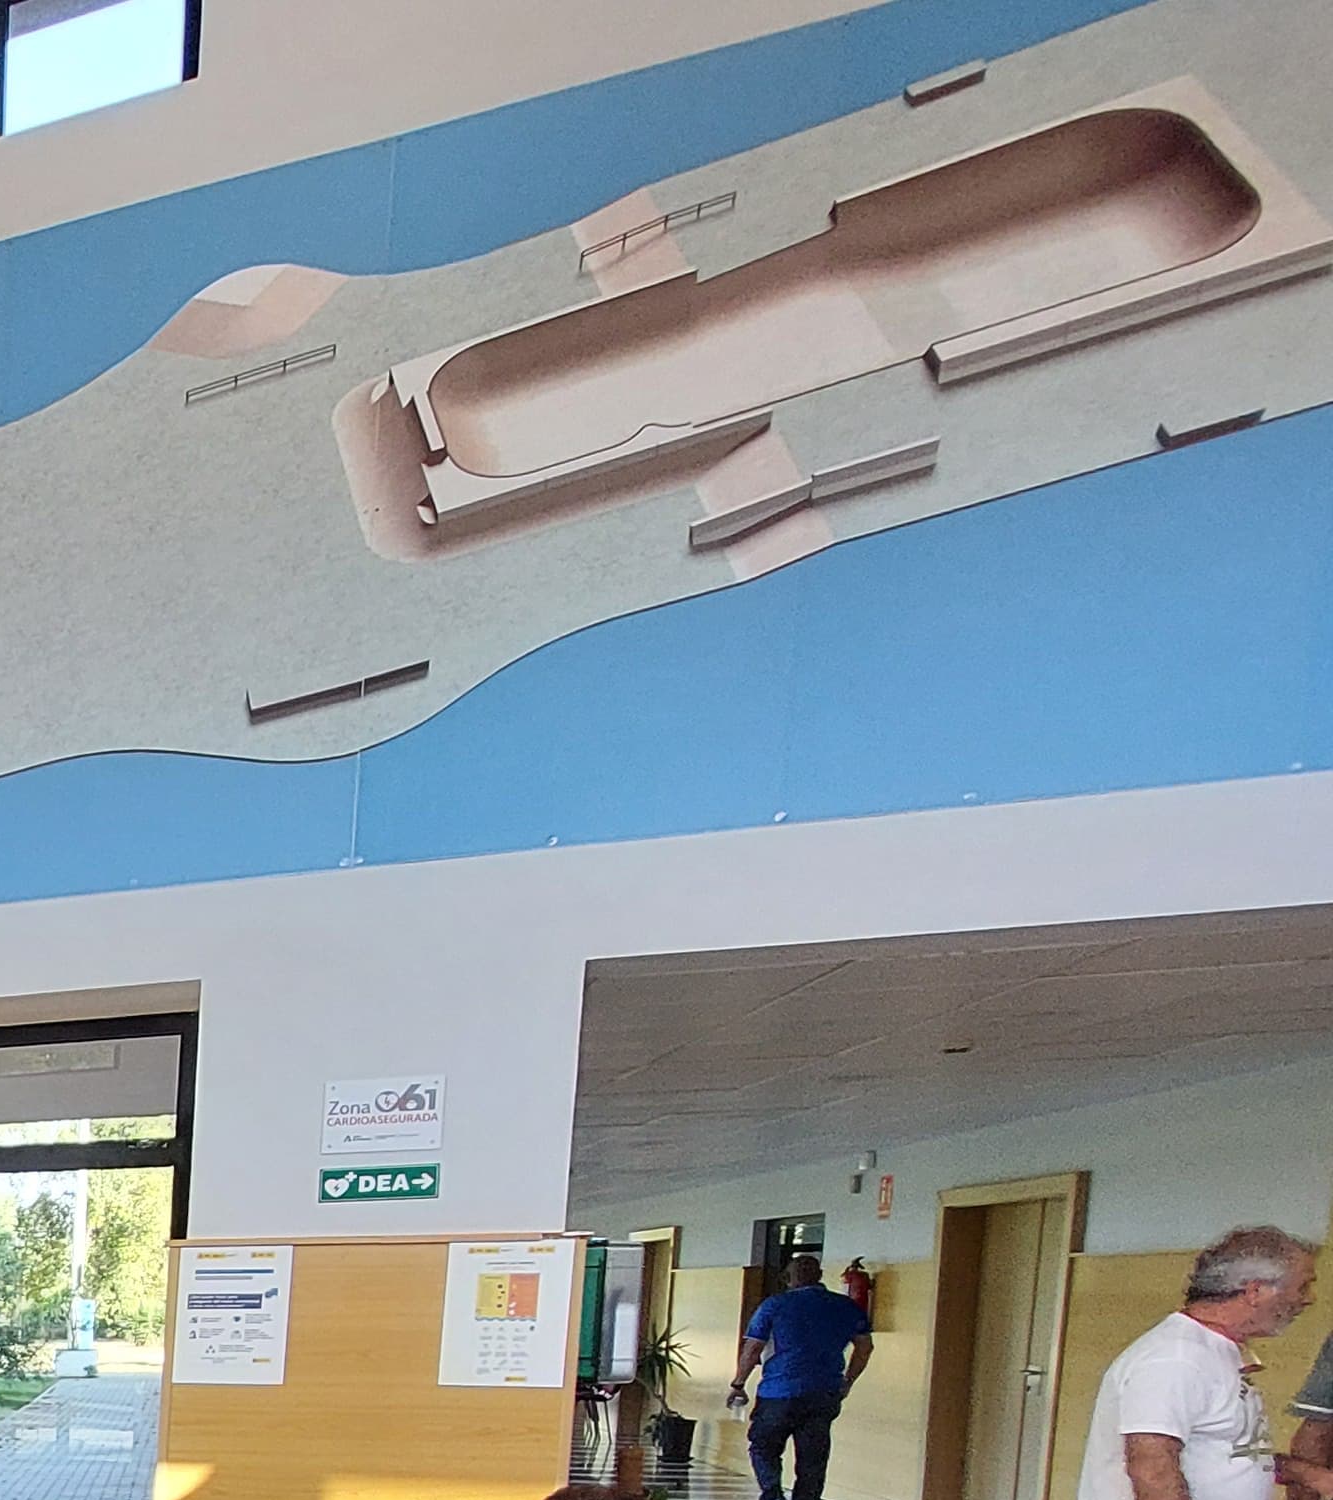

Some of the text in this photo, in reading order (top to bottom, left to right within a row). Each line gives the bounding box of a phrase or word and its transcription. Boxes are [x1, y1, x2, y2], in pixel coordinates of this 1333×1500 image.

[328, 1100, 371, 1116] Zona
[326, 1112, 439, 1128] CARDIOASEGURADA
[357, 1173, 411, 1193] DEA
